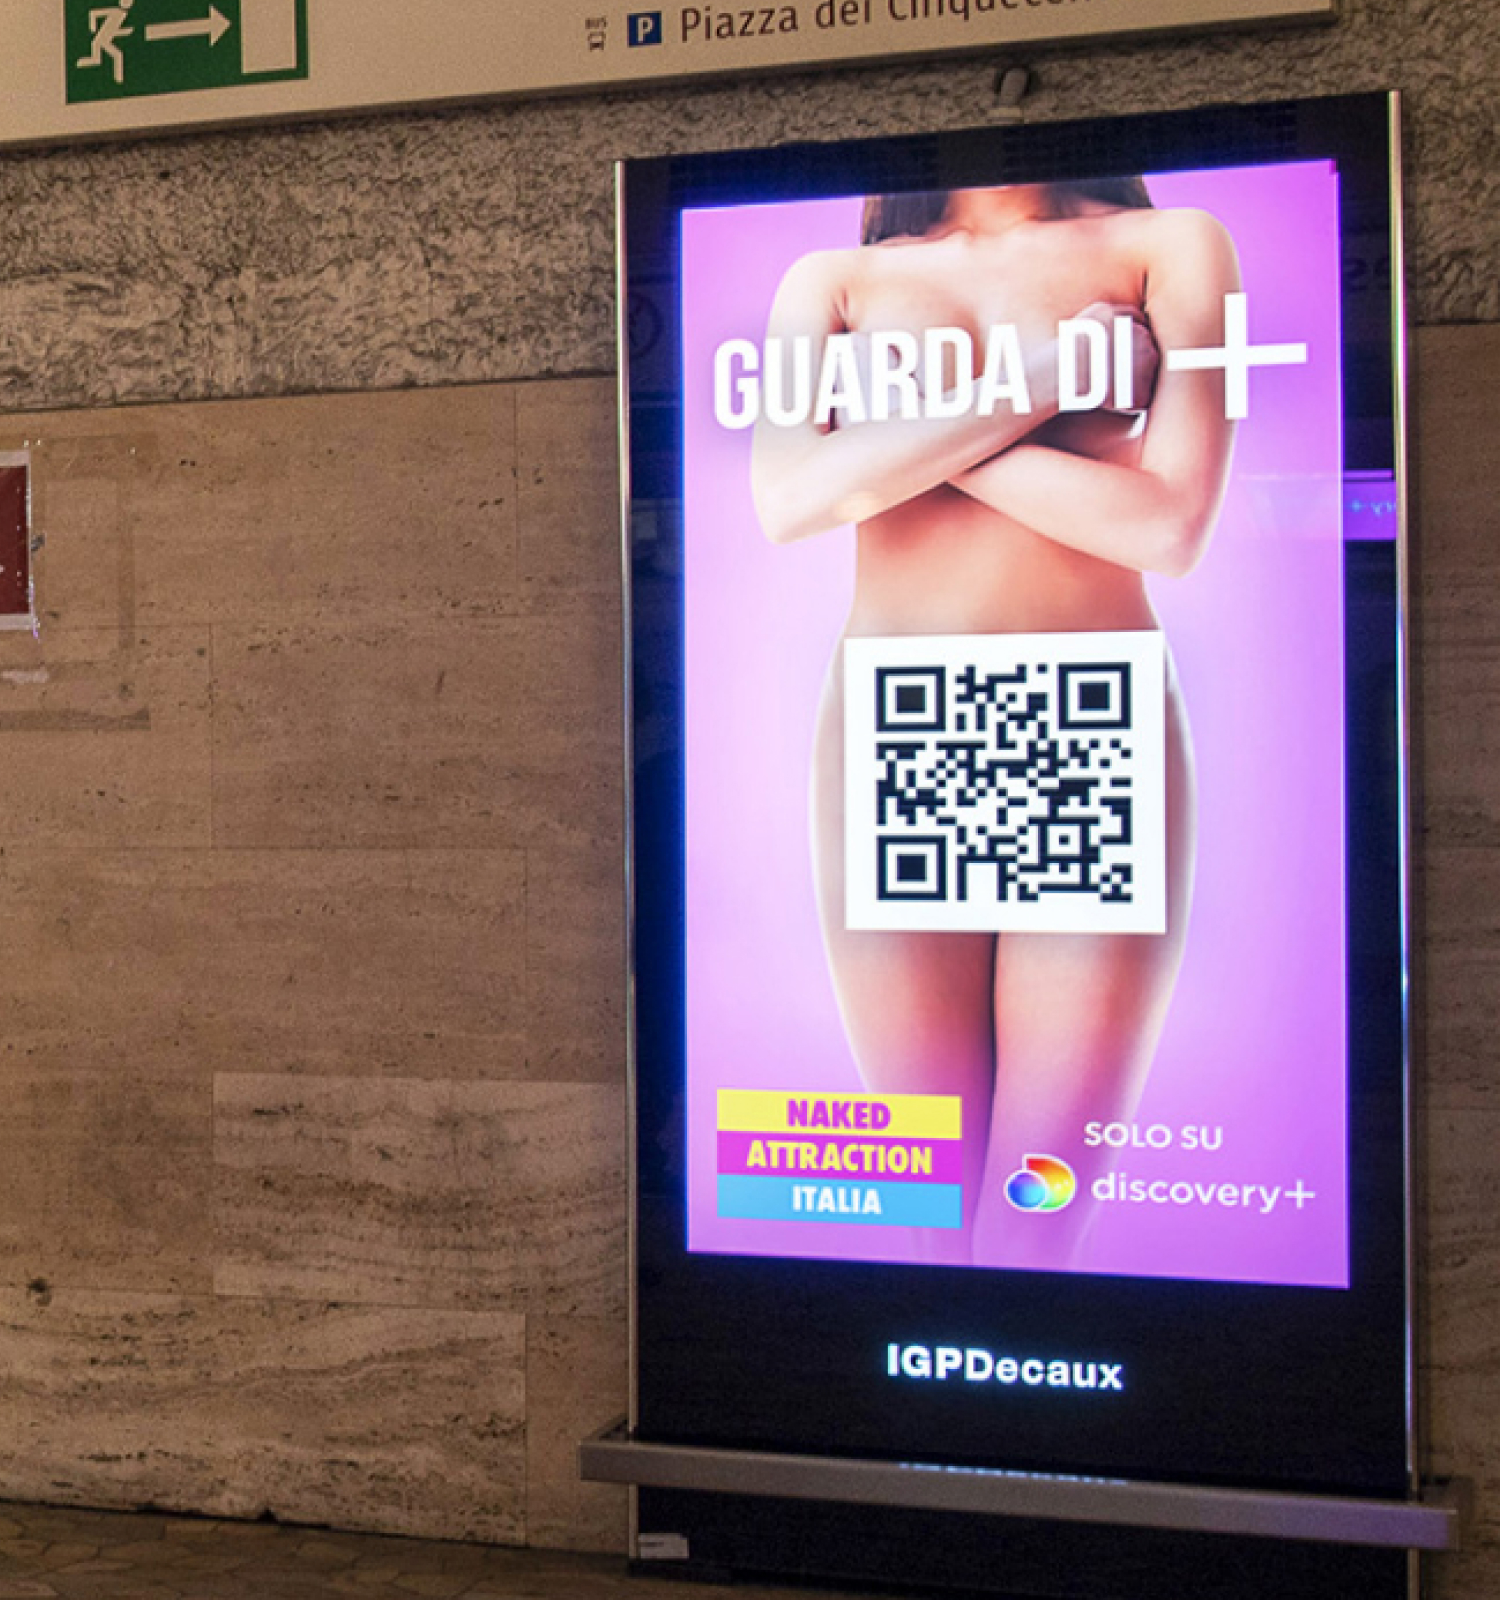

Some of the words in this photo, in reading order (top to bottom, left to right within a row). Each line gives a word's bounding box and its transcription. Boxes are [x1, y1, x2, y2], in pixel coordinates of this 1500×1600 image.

[681, 5, 799, 43] Piazza
[713, 323, 1032, 430] GUARDA
[1058, 315, 1135, 412] DI
[786, 1097, 892, 1131] NAKED
[1083, 1121, 1172, 1150] SOLO
[1180, 1124, 1223, 1151] SU
[746, 1139, 933, 1175] ATTRACTION
[792, 1185, 883, 1216] ITALIA
[1092, 1173, 1316, 1214] discovery+
[886, 1342, 1123, 1391] IGPDecaux
